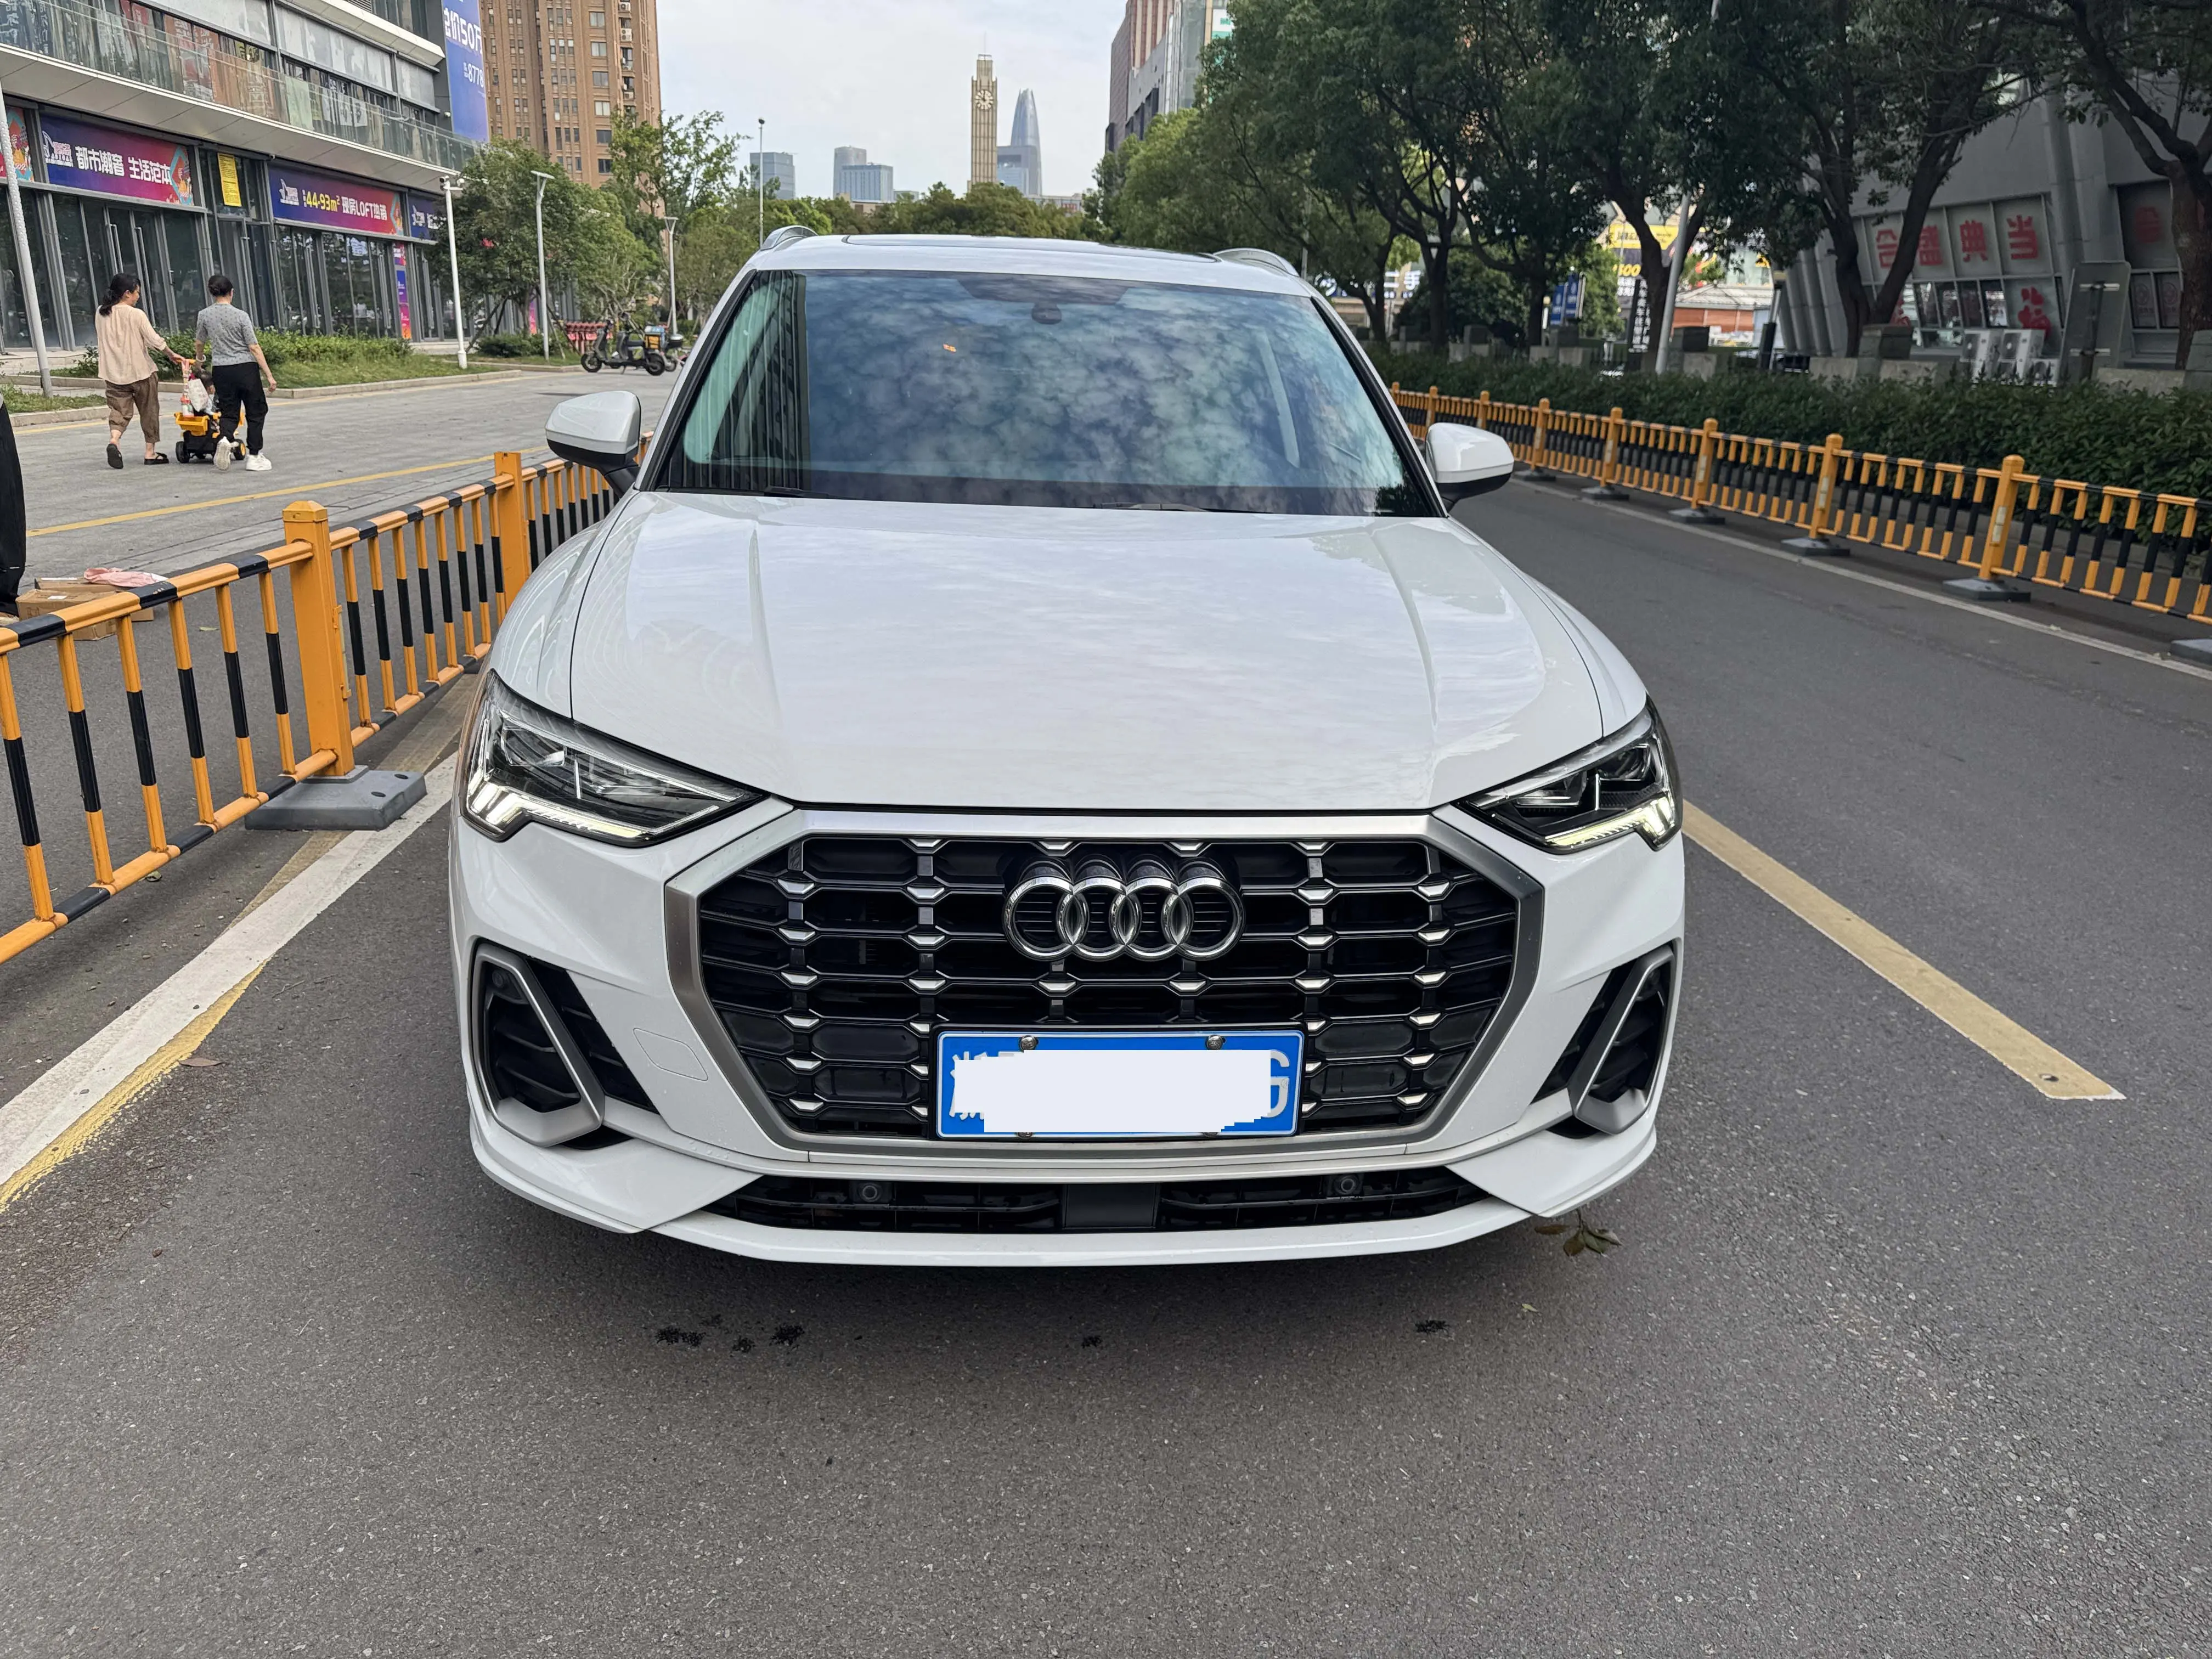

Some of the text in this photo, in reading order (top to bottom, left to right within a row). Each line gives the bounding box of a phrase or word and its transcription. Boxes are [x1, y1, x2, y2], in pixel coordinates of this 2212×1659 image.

[75, 145, 125, 176] 都市潮奢
[128, 156, 172, 185] 生活范本
